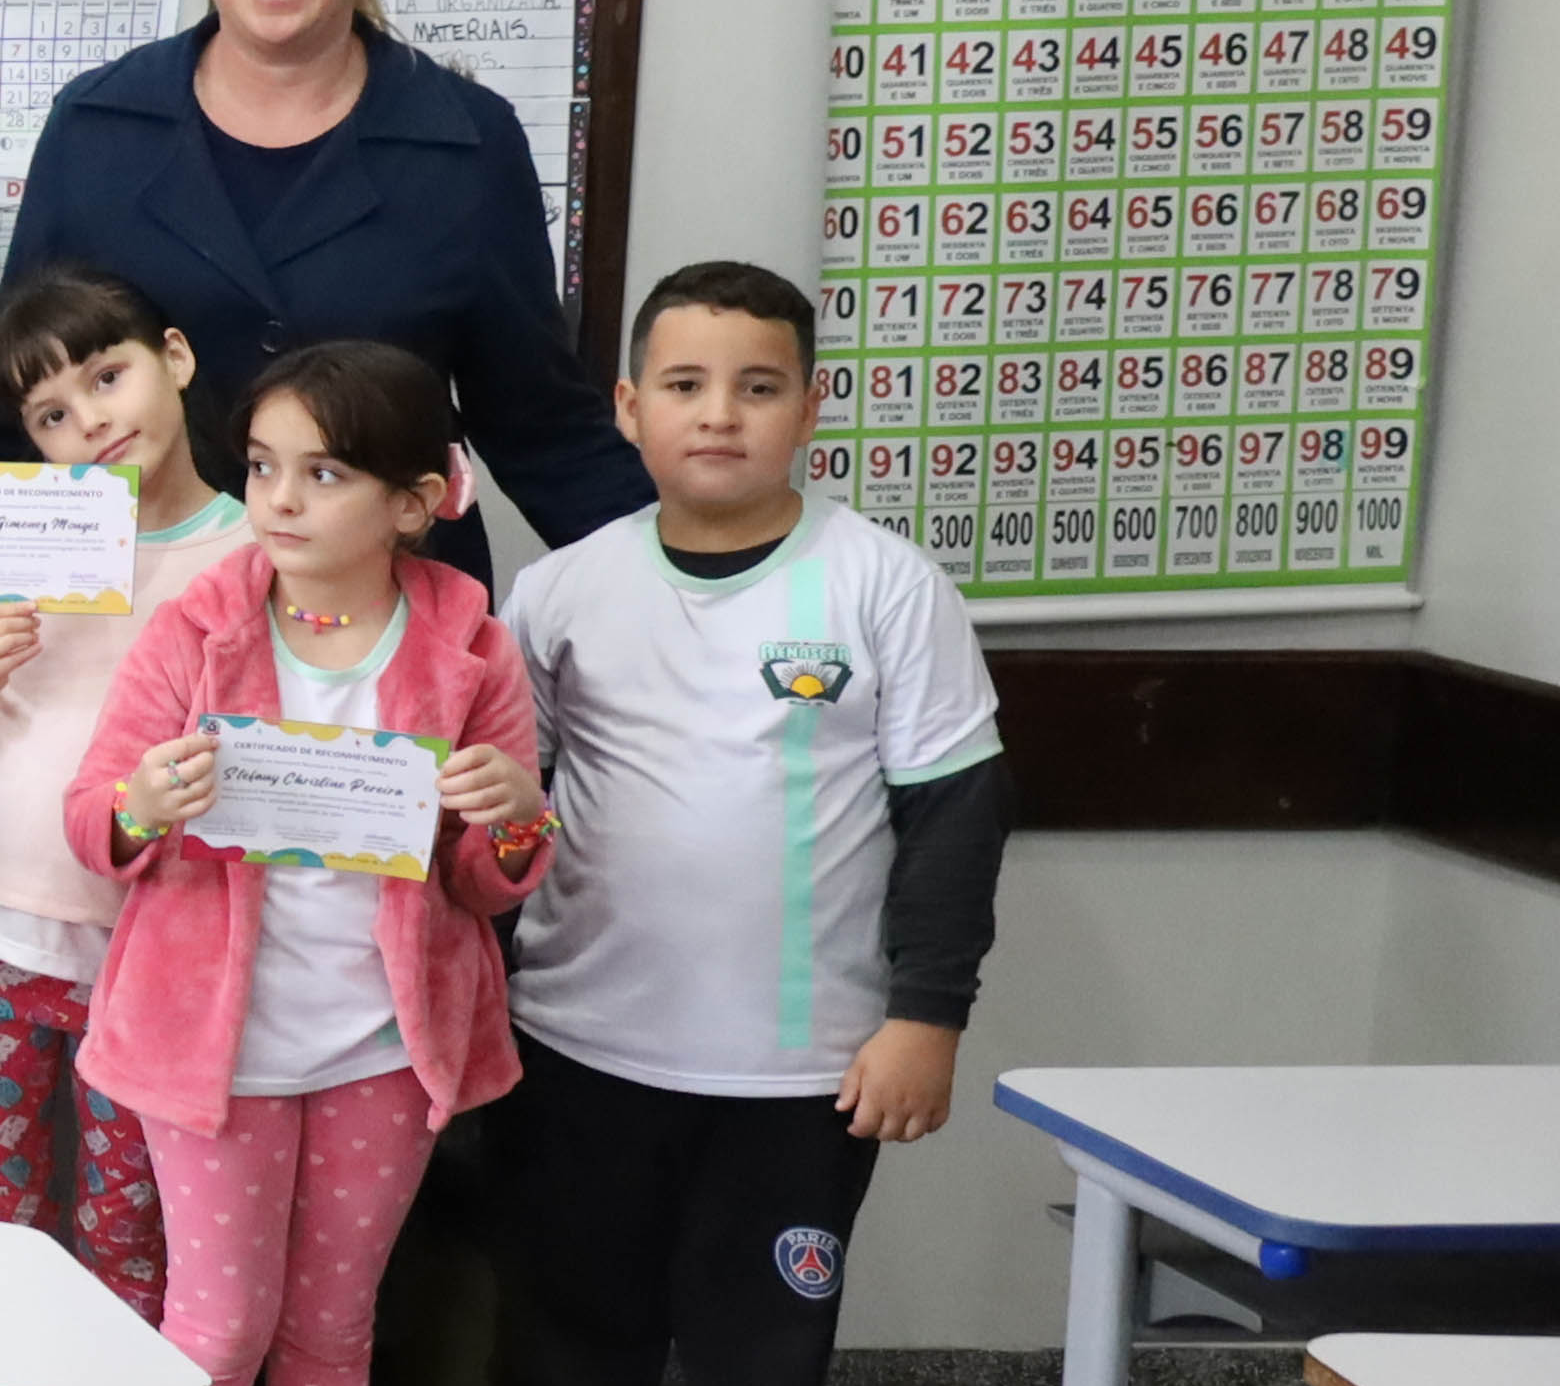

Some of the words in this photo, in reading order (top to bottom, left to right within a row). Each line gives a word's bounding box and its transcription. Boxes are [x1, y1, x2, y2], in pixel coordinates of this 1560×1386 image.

[1382, 109, 1431, 142] 59
[1360, 427, 1408, 458] 99
[1358, 499, 1401, 530] 1000
[785, 1233, 834, 1250] PARIS
